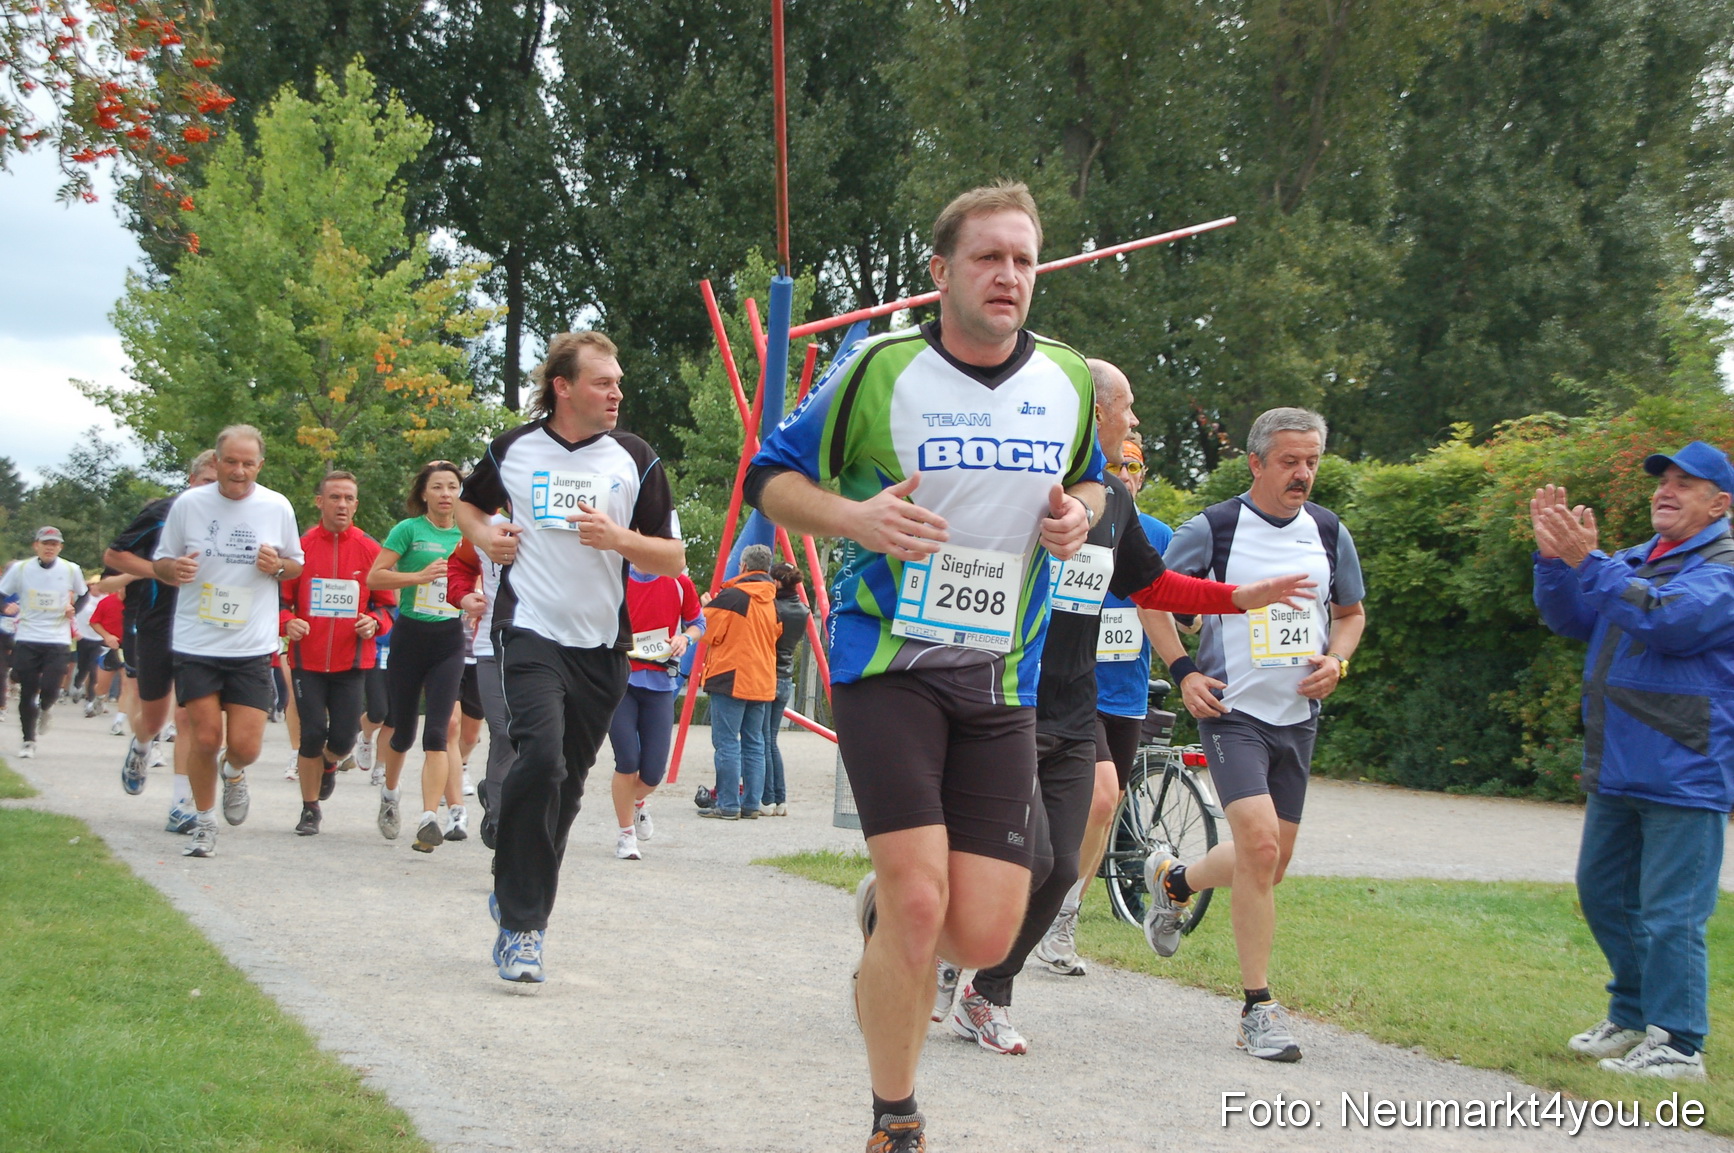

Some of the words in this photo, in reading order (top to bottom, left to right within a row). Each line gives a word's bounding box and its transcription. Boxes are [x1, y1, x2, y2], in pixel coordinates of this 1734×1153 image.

[922, 413, 991, 427] TEAM
[918, 437, 1065, 475] BOCK
[553, 476, 592, 490] Juergen
[553, 492, 597, 509] 2061
[941, 552, 1006, 579] Siegfried
[910, 575, 919, 589] B
[1063, 569, 1104, 591] 2442
[325, 593, 354, 605] 2550
[936, 583, 1006, 616] 2698
[222, 602, 240, 615] 97
[1271, 607, 1311, 623] Siegfried
[966, 632, 1010, 646] PFLEIDERER
[1104, 629, 1133, 644] 802
[1253, 628, 1259, 638] C
[1280, 627, 1309, 645] 241
[642, 641, 664, 655] 906
